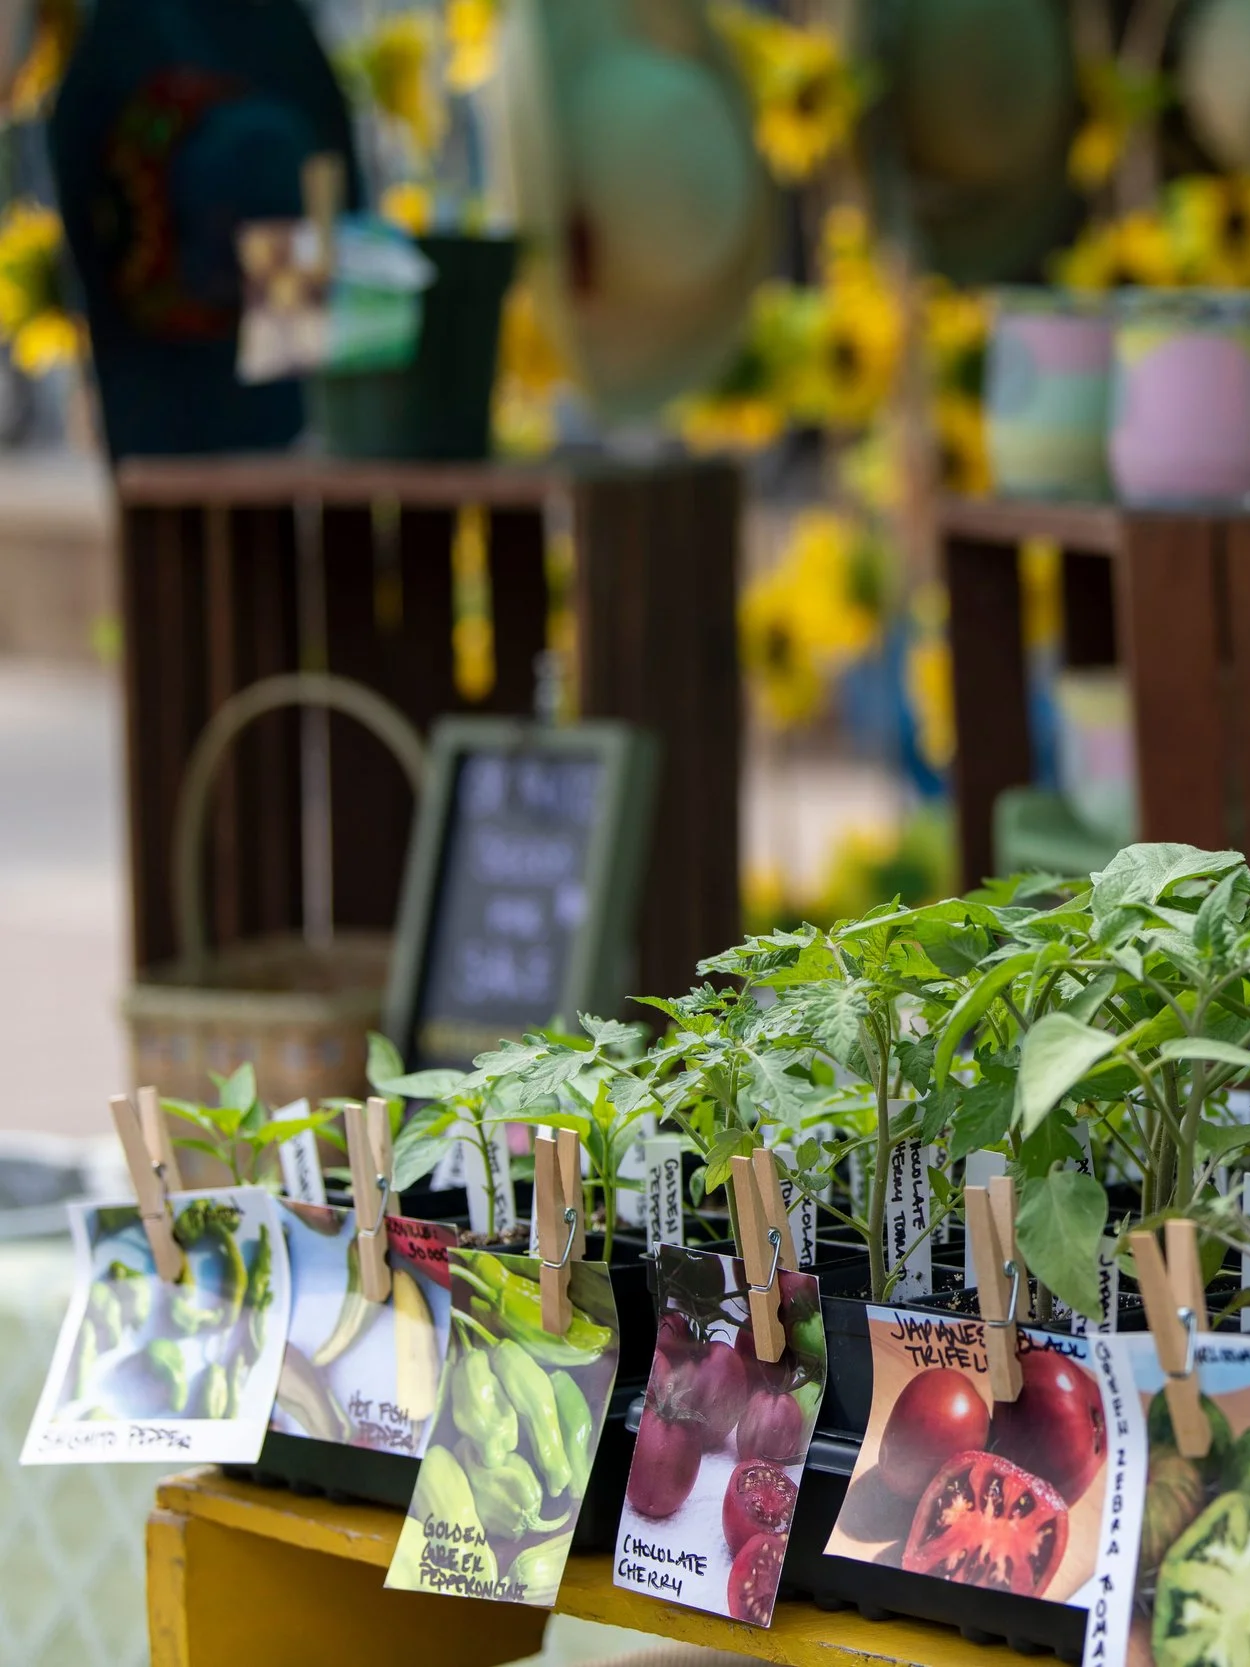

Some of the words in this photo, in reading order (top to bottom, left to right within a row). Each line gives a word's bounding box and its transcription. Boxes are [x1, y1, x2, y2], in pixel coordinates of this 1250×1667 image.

[891, 1140, 906, 1203] HERRY
[910, 1136, 926, 1230] HOCOLATE
[663, 1157, 680, 1236] GOLDEN
[890, 1311, 988, 1349] JAPANES
[904, 1345, 989, 1374] TRIFEL
[349, 1389, 374, 1420] HOT
[379, 1401, 410, 1427] FISH
[1106, 1448, 1127, 1555] ZEBRA
[422, 1511, 488, 1548] GOLDEN
[420, 1540, 485, 1575] GREEK
[622, 1533, 708, 1577] CHOCOLATE
[617, 1557, 683, 1598] CHERRY
